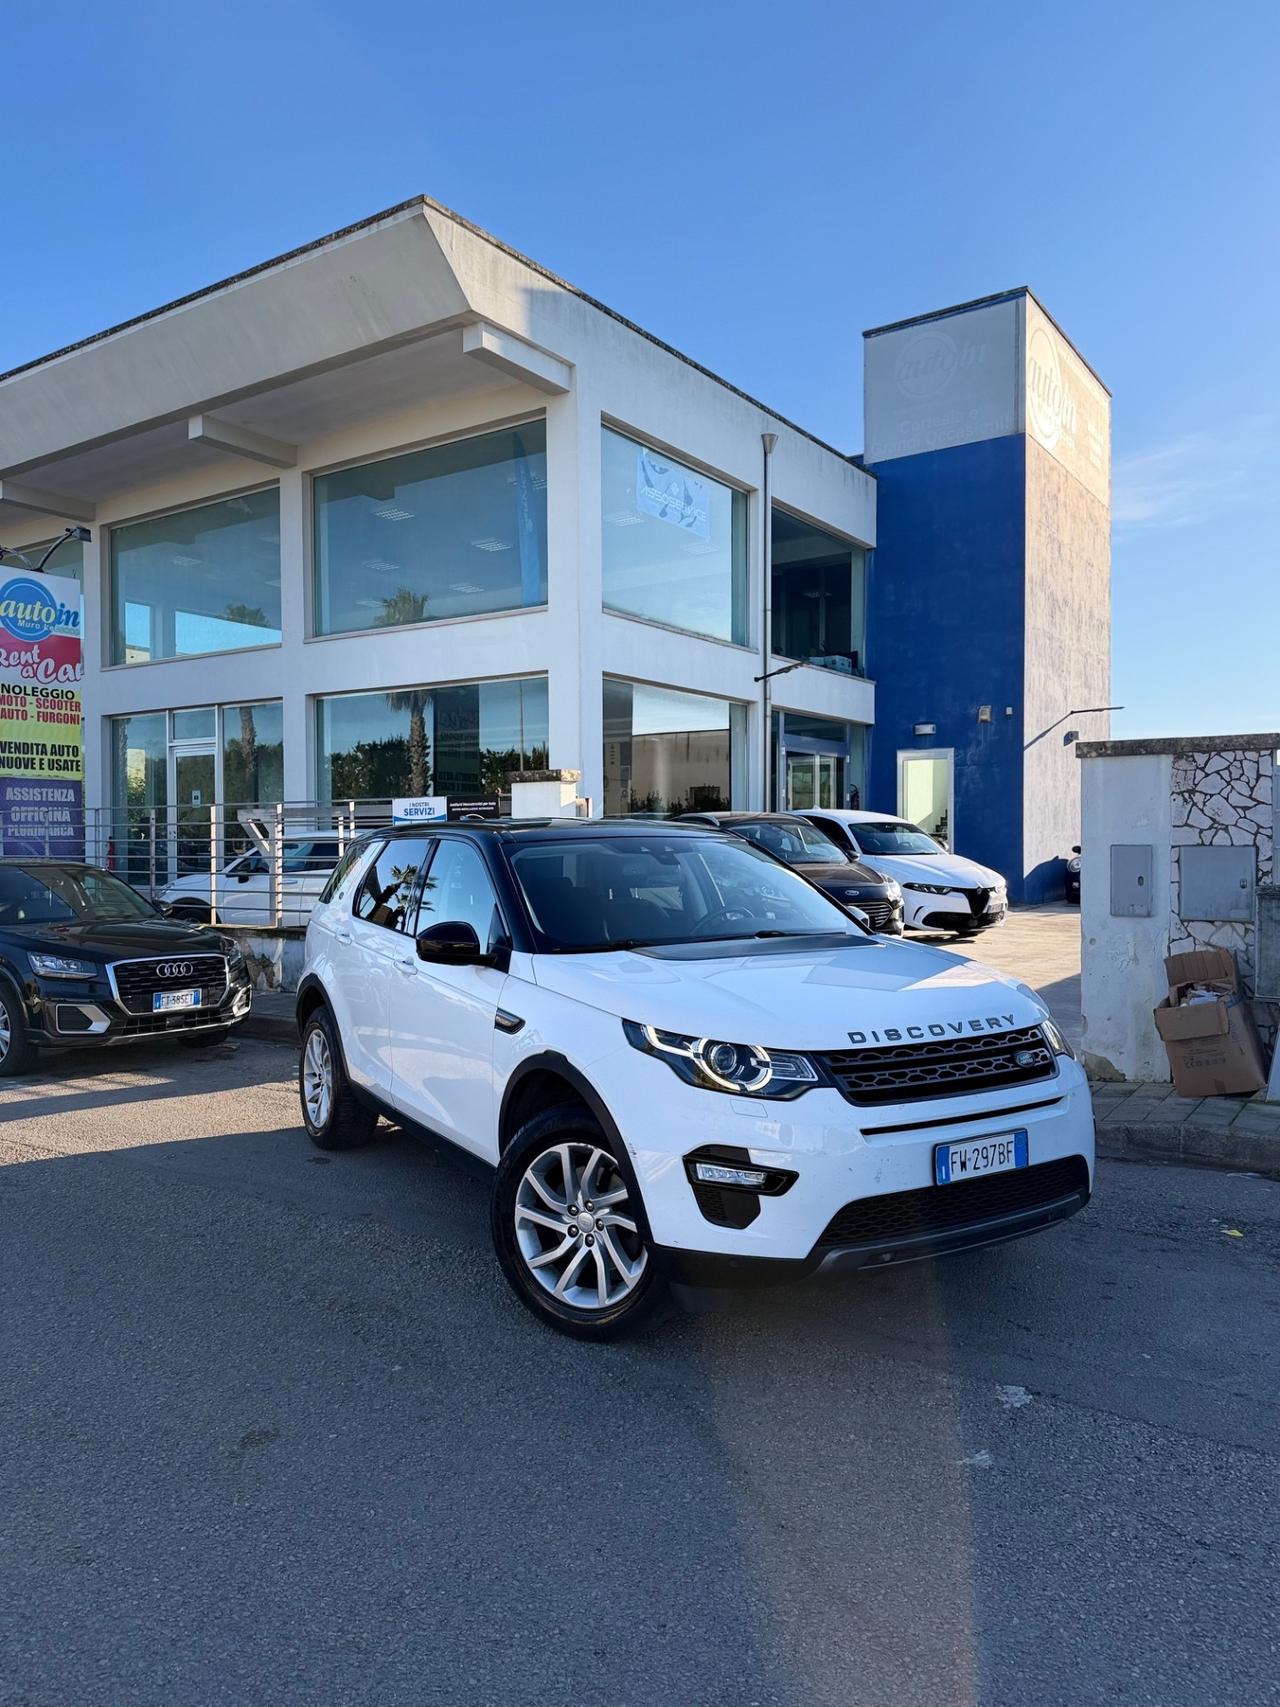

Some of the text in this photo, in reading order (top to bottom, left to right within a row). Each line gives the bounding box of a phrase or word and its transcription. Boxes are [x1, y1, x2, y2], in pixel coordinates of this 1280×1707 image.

[1, 683, 75, 700] NOLEGGIO
[0, 694, 27, 708] MOTO
[36, 697, 81, 713] SCOOTER
[0, 708, 28, 721] AUTO
[37, 711, 80, 725] FURGONI
[0, 741, 79, 758] VENDITA AUTO
[0, 755, 81, 772] NUOVE E USATE
[5, 787, 75, 802] ASSISTENZA
[10, 806, 71, 822] OFFICINA
[403, 807, 436, 817] SERVIZI
[847, 1014, 1016, 1044] DISCOVERY
